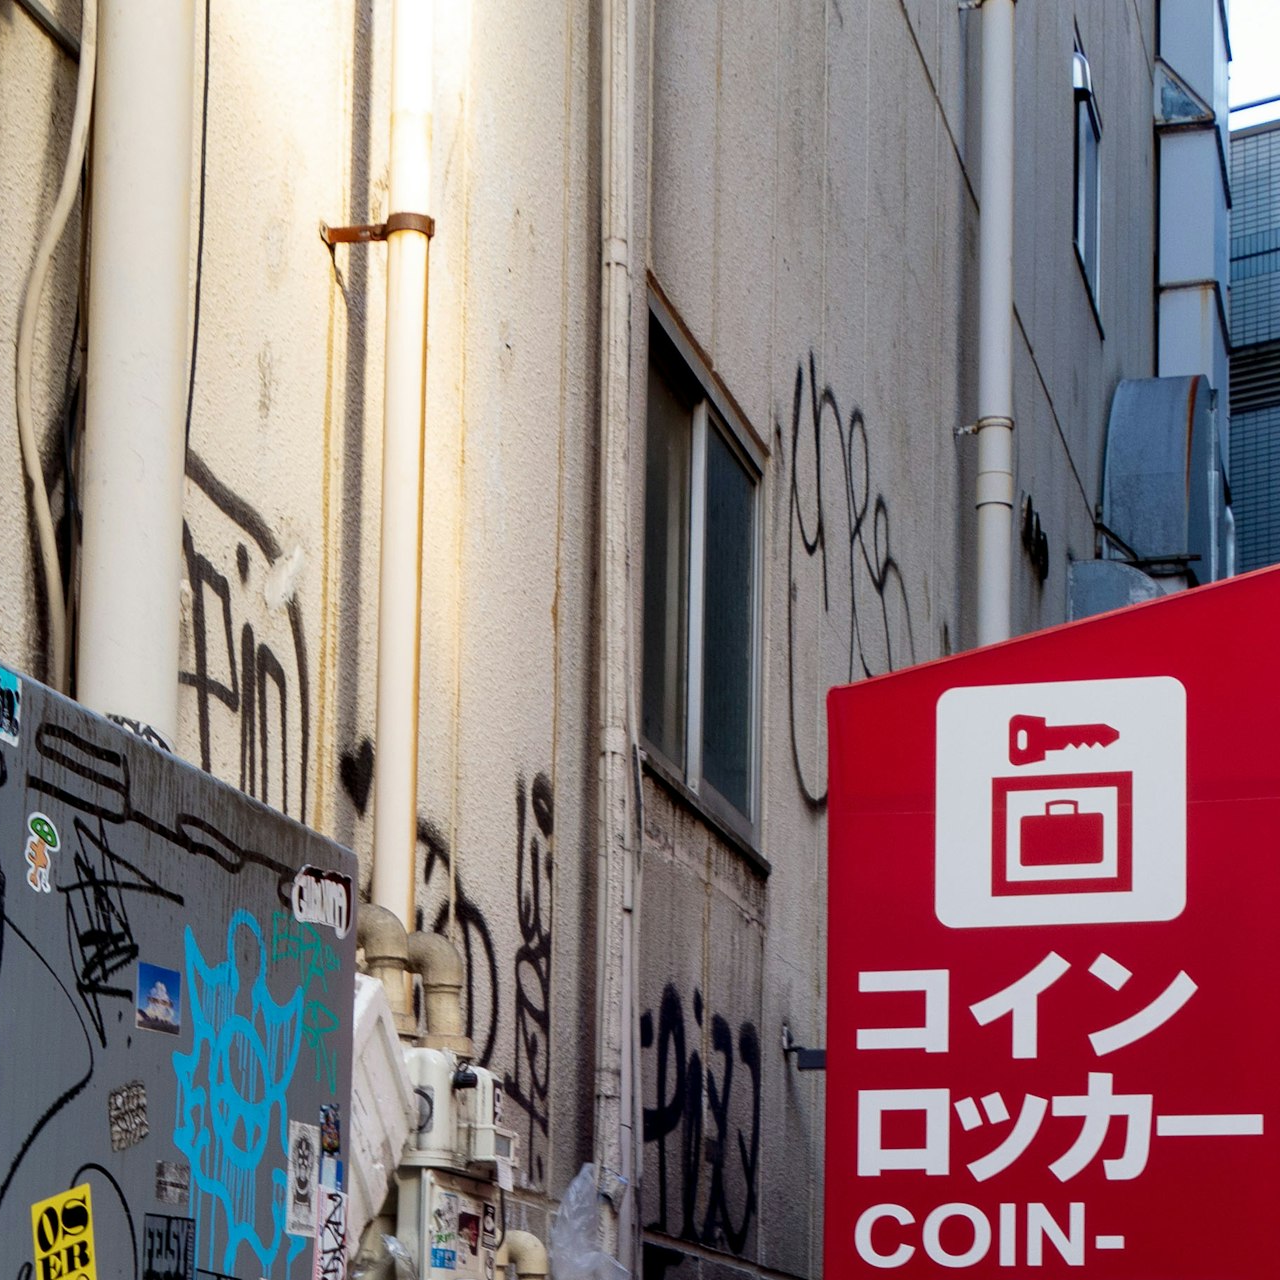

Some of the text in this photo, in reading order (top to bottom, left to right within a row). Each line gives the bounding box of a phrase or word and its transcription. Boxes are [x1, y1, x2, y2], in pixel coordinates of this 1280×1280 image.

[856, 951, 1198, 1059] コイン
[857, 1071, 1264, 1182] ロッカー
[854, 1202, 1125, 1268] COIN-
